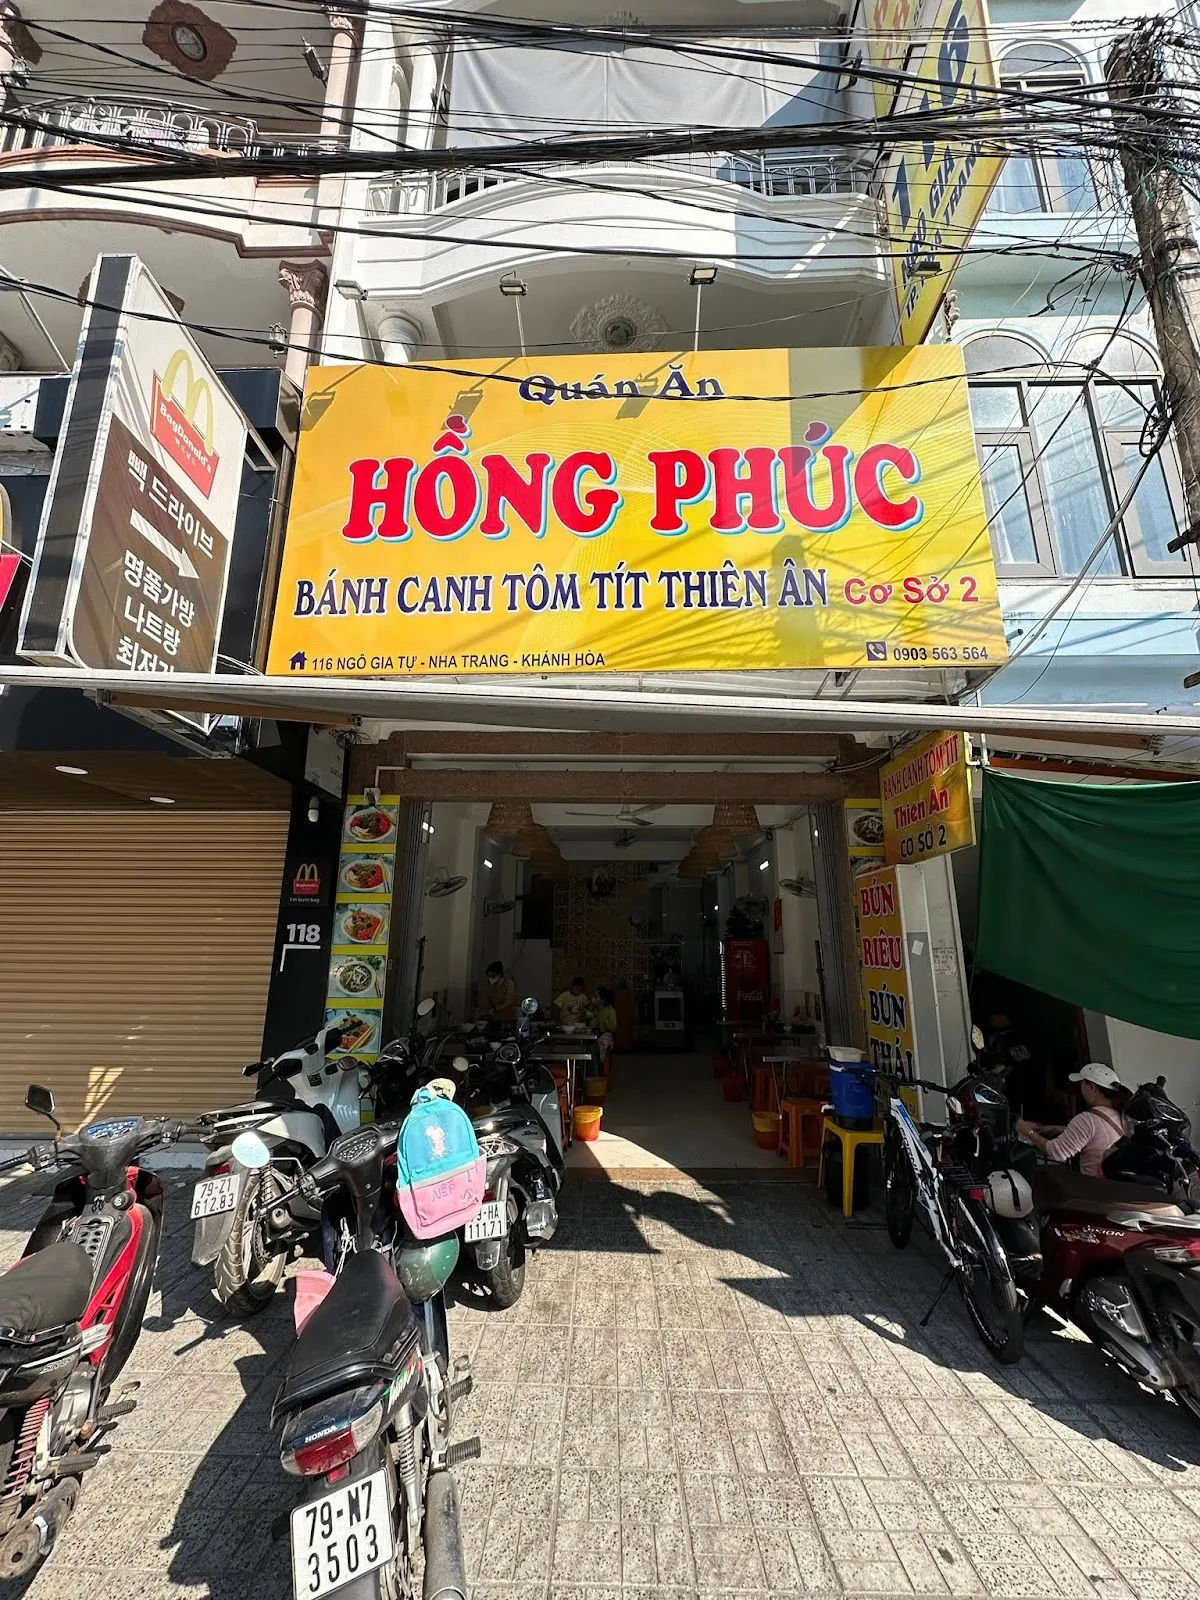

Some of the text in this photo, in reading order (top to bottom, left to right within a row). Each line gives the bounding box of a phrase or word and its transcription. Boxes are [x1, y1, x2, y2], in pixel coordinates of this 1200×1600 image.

[519, 364, 725, 405] Quán Ăn
[160, 401, 212, 474] BagDonald's
[341, 414, 924, 541] HỒNG PHÚC
[149, 475, 214, 559] 드라이브
[124, 550, 195, 628] 명품가방
[294, 558, 827, 616] BÁNH CANH TÔM TÍT THIÊN ÂN
[844, 576, 979, 605] Cơ Sở 2
[124, 595, 181, 656] 나트랑
[312, 657, 333, 671] 116
[337, 653, 367, 670] NGÔ
[371, 656, 394, 670] GIA
[399, 655, 418, 672] TỰ
[429, 655, 458, 668] NHA
[462, 654, 509, 668] TRANG
[522, 650, 570, 667] KHÁNH
[575, 649, 605, 666] HÒA
[893, 646, 988, 661] 0903 563 564
[938, 825, 947, 847] 2
[859, 878, 894, 917] BÚN
[287, 923, 321, 943] 118
[862, 930, 903, 969] RIÊU
[868, 983, 906, 1031] BÚN
[194, 1192, 234, 1216] 612.83
[200, 1177, 232, 1198] 79-Z1
[469, 1220, 502, 1239] 111.71
[304, 1425, 338, 1444] HONDA
[305, 1480, 373, 1548] 79-N7
[307, 1523, 380, 1593] 3503
